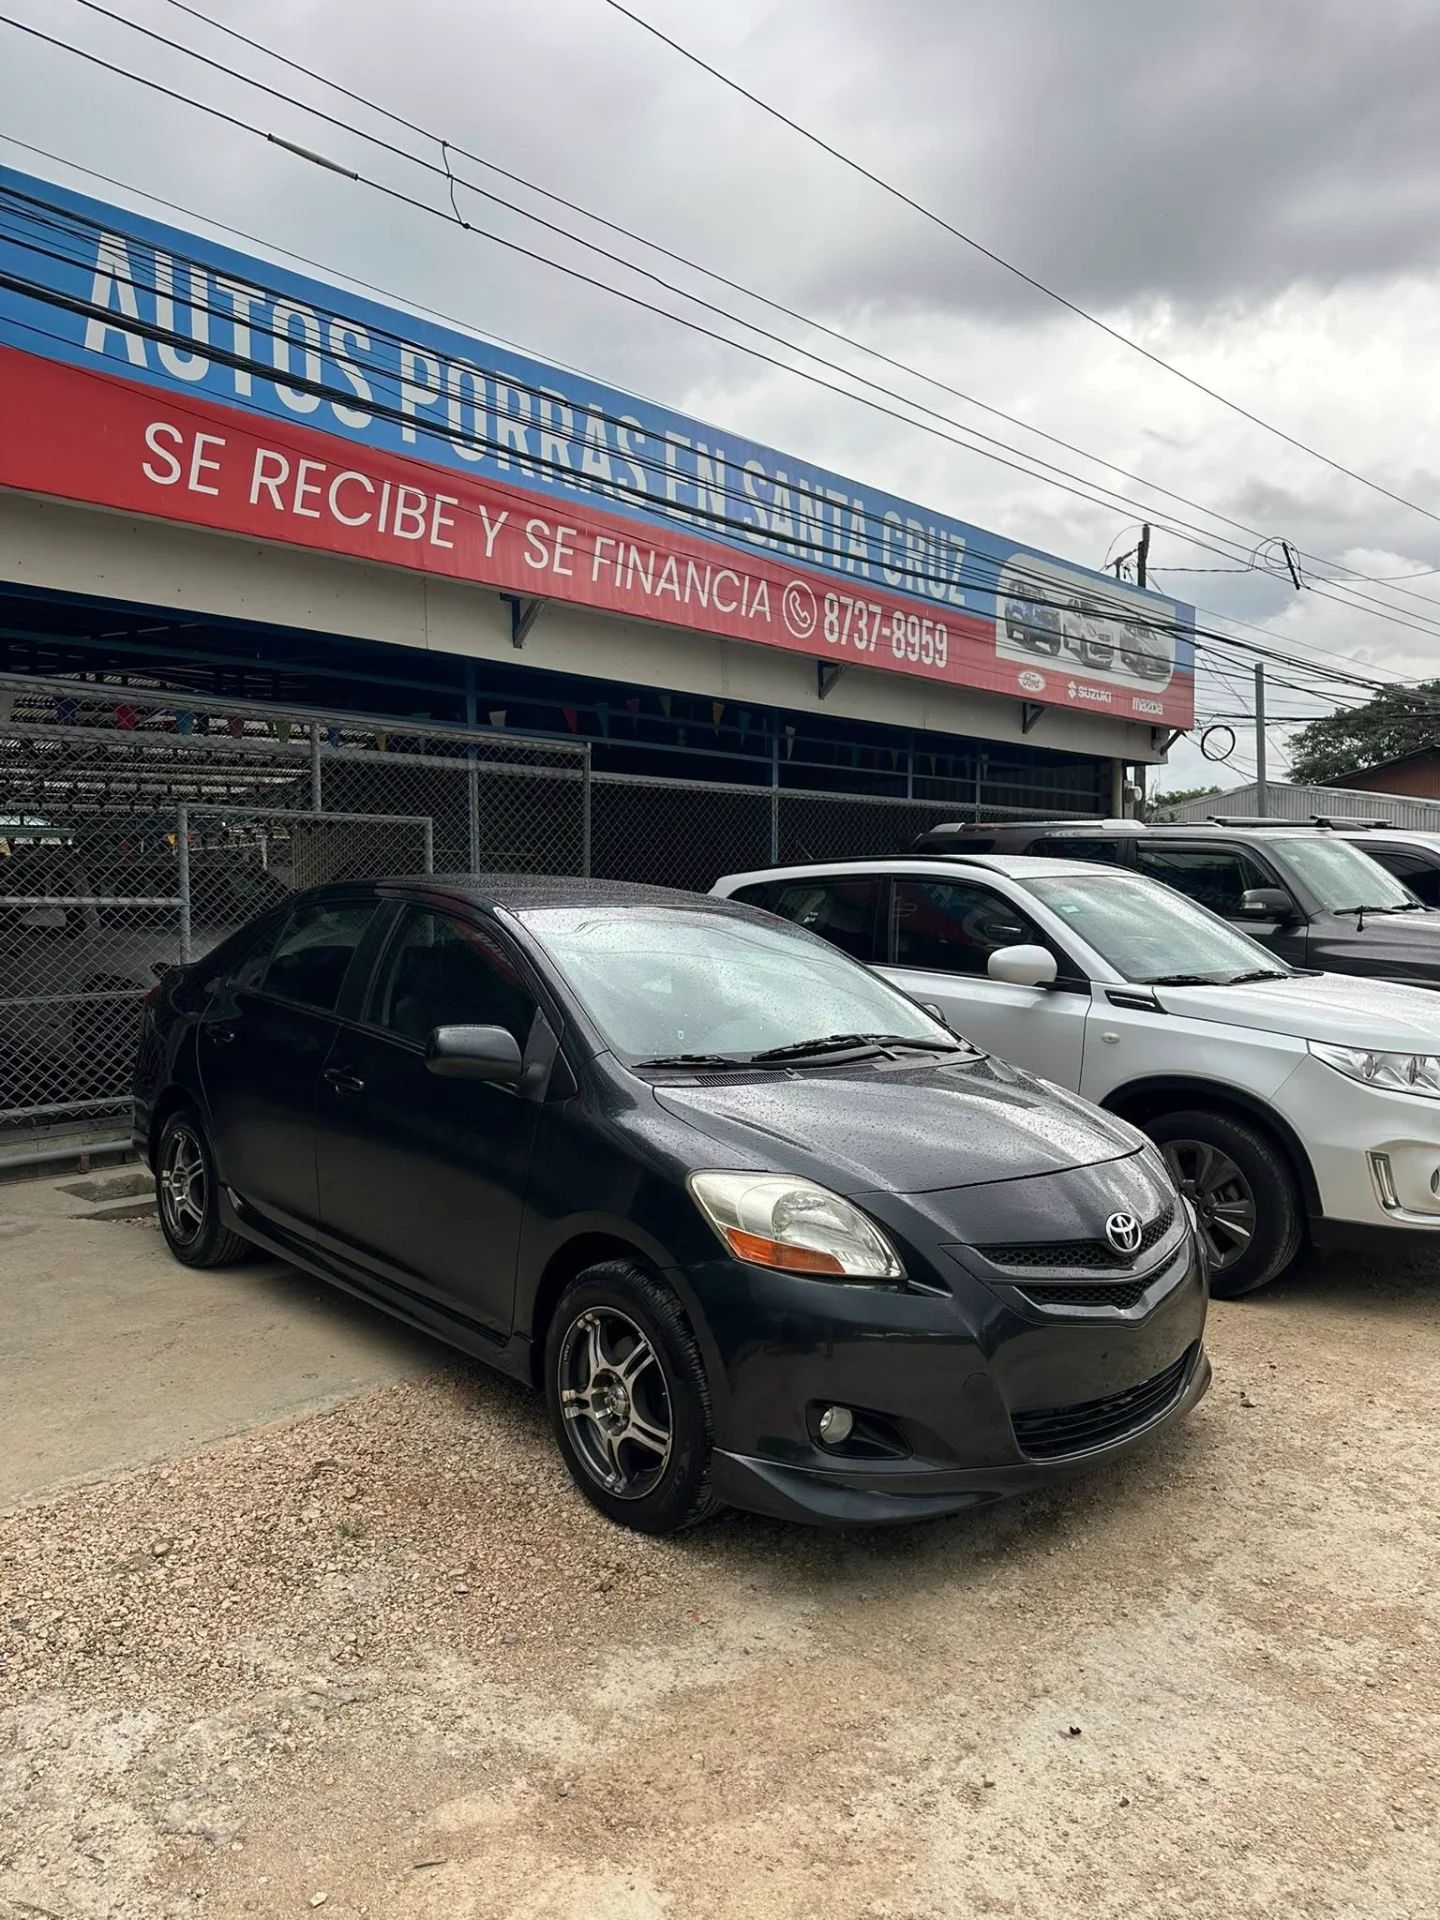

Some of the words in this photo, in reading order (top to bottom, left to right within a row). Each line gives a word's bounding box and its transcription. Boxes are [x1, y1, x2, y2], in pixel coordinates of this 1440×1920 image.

[84, 230, 374, 429] AUTOS
[401, 341, 647, 509] PORRAS
[665, 430, 726, 533] EN
[742, 460, 870, 578] SANTA
[882, 510, 966, 606] CRUZ
[142, 421, 226, 496] SE
[250, 447, 459, 549] RECIBE
[479, 504, 509, 558] Y
[524, 518, 577, 576] SE
[591, 535, 771, 623] FINANCIA
[823, 592, 949, 668] 8737-8959
[1078, 685, 1112, 703] SUZUKI
